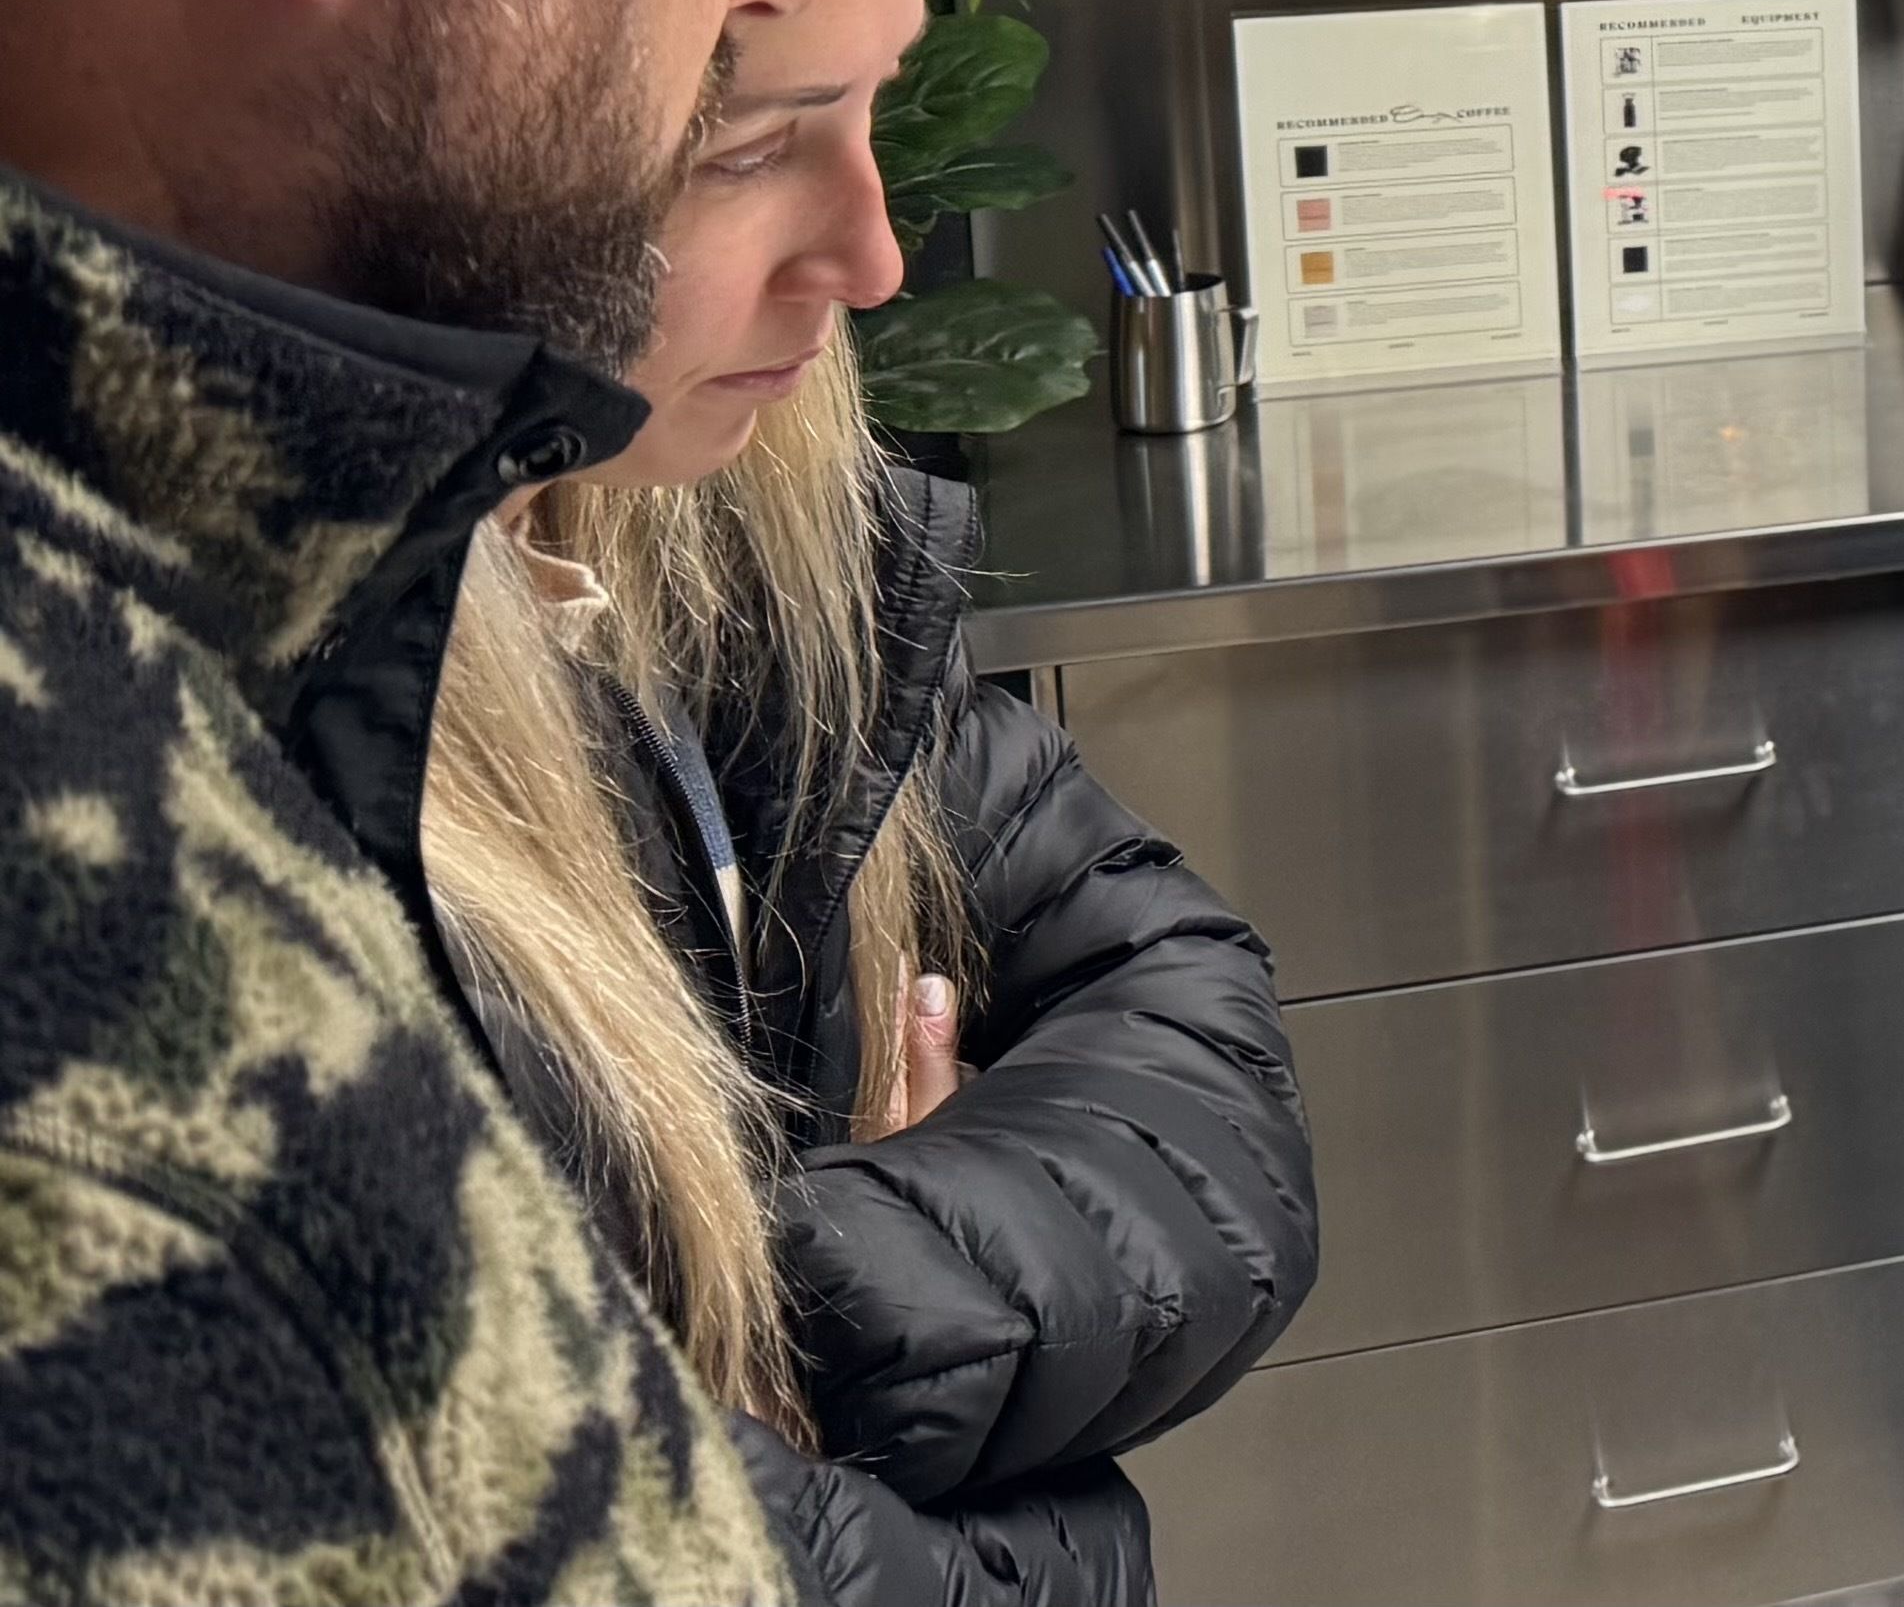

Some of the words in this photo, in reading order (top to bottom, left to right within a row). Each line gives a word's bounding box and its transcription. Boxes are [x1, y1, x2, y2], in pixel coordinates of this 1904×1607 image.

[1600, 18, 1706, 31] RECOMMENDED
[1742, 12, 1820, 25] EQUIPMENT
[1277, 114, 1388, 130] RECOMMENDED
[1456, 106, 1511, 119] COFFEE
